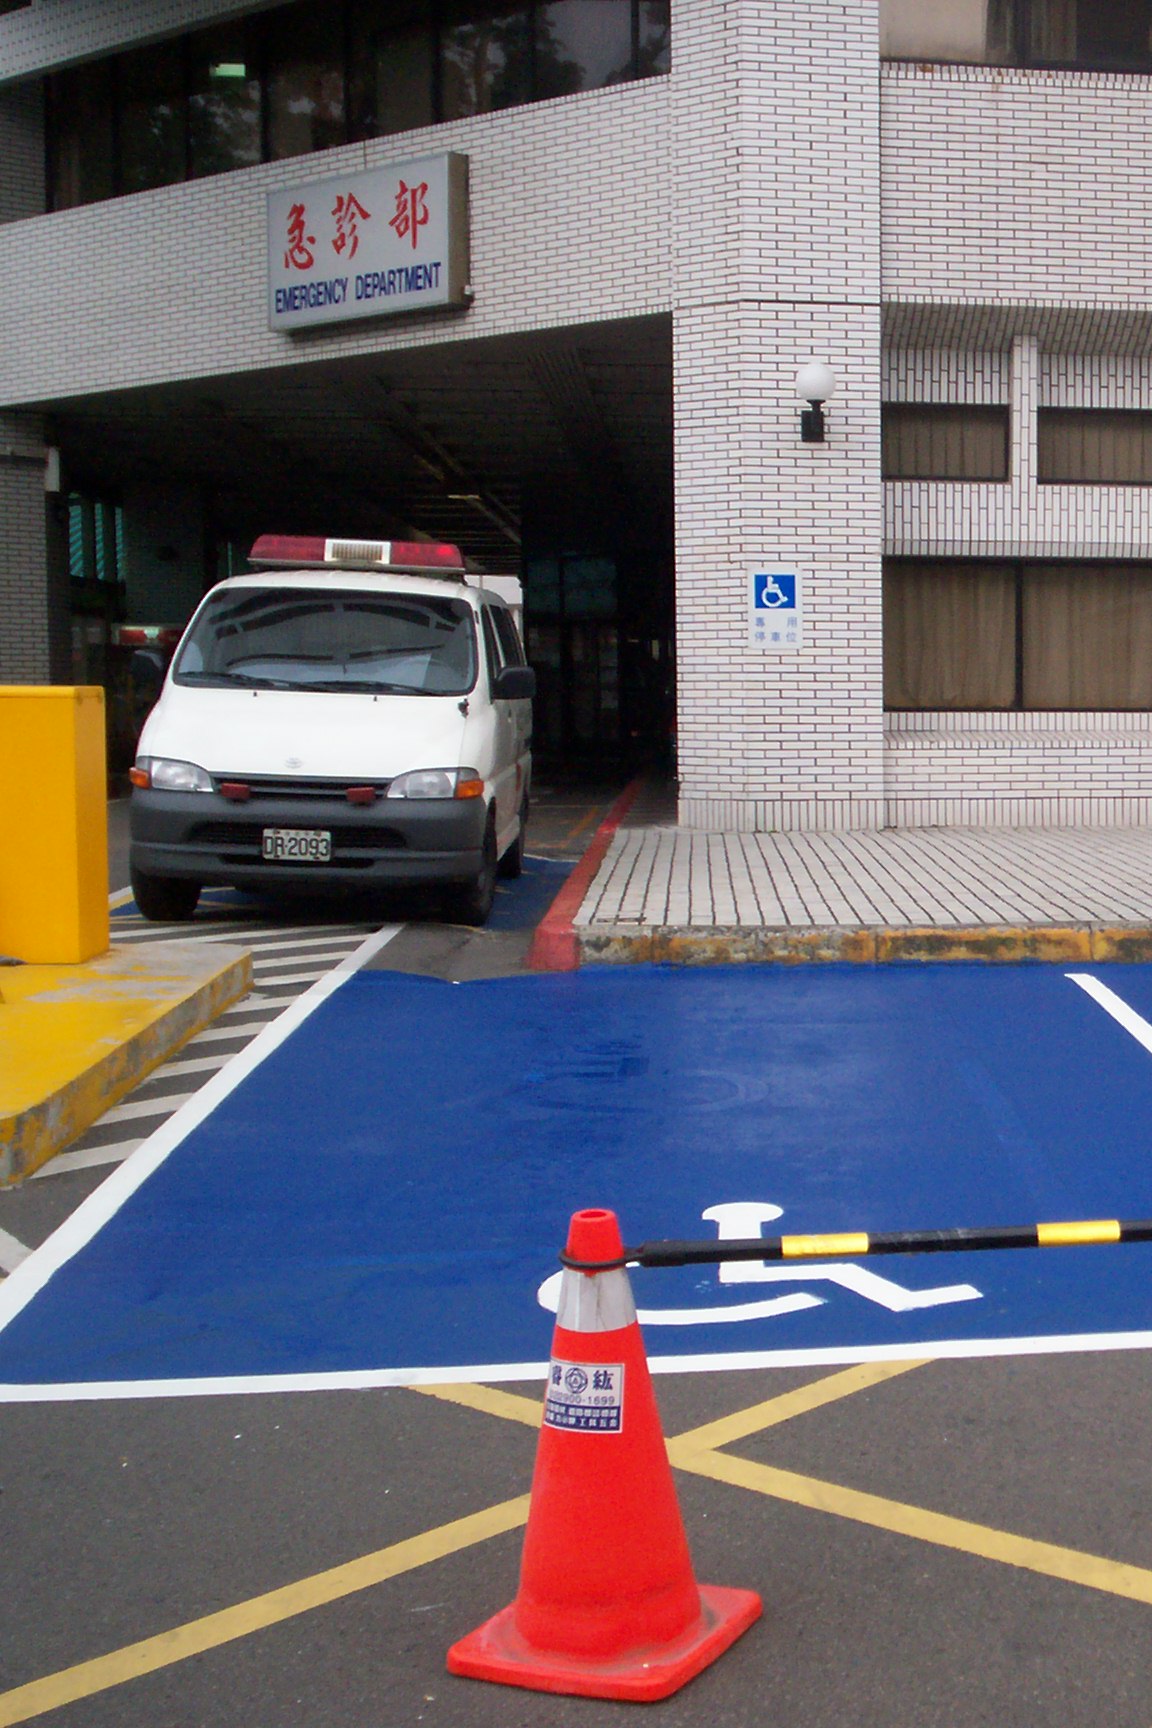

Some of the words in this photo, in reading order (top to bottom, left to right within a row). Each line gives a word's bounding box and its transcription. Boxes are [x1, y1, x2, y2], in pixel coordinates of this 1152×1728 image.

[283, 180, 429, 270] 急診部
[275, 277, 349, 314] EMERGENCY
[355, 261, 442, 301] DEPARTMENT
